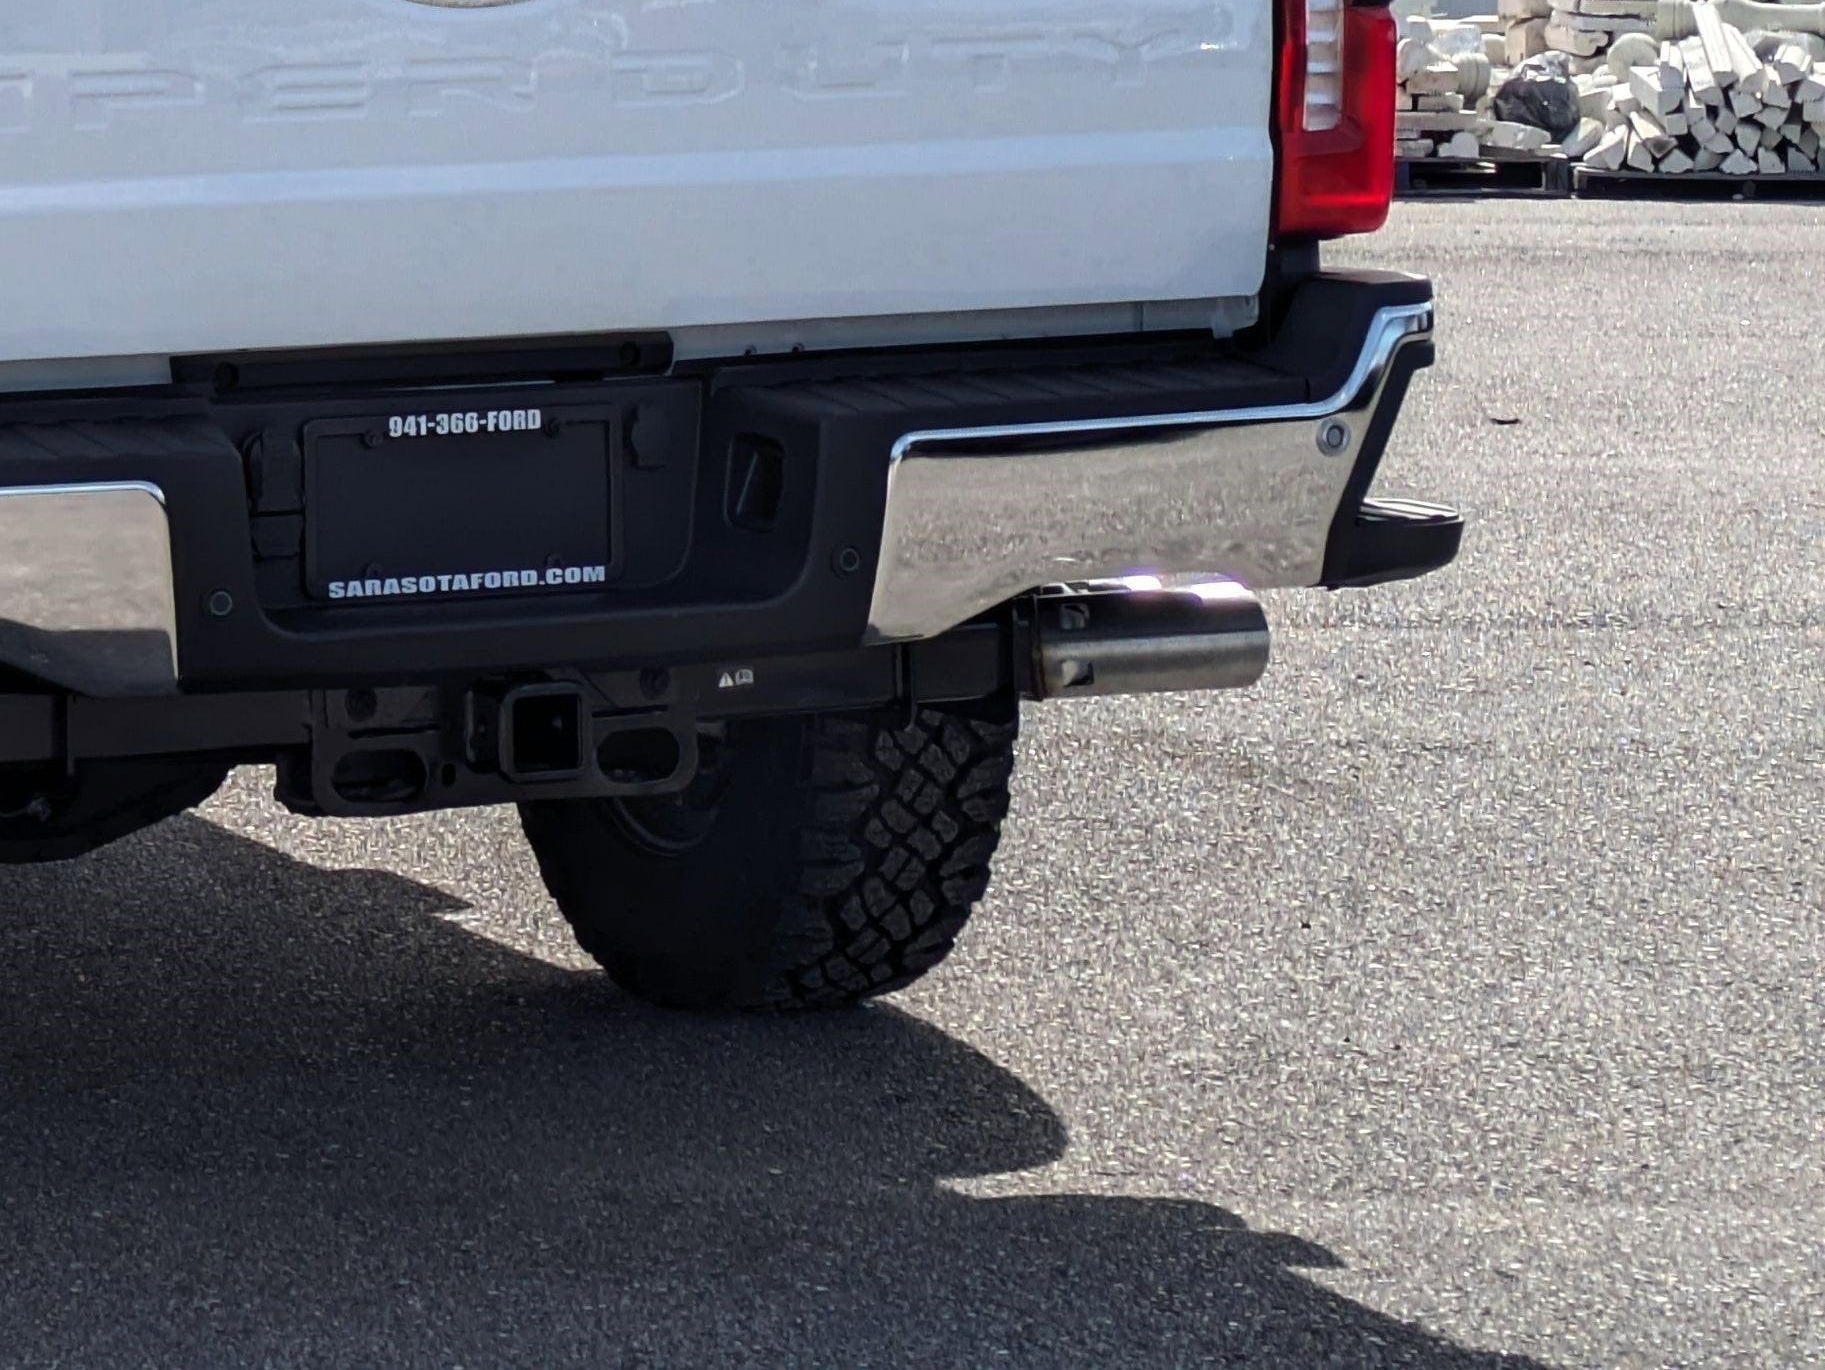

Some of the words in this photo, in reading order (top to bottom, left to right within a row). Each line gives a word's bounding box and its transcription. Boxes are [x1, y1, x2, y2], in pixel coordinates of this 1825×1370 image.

[610, 26, 1190, 108] DUTY
[388, 408, 542, 437] 941-366-FORD
[328, 565, 606, 599] SARASOTAFORD.COM
